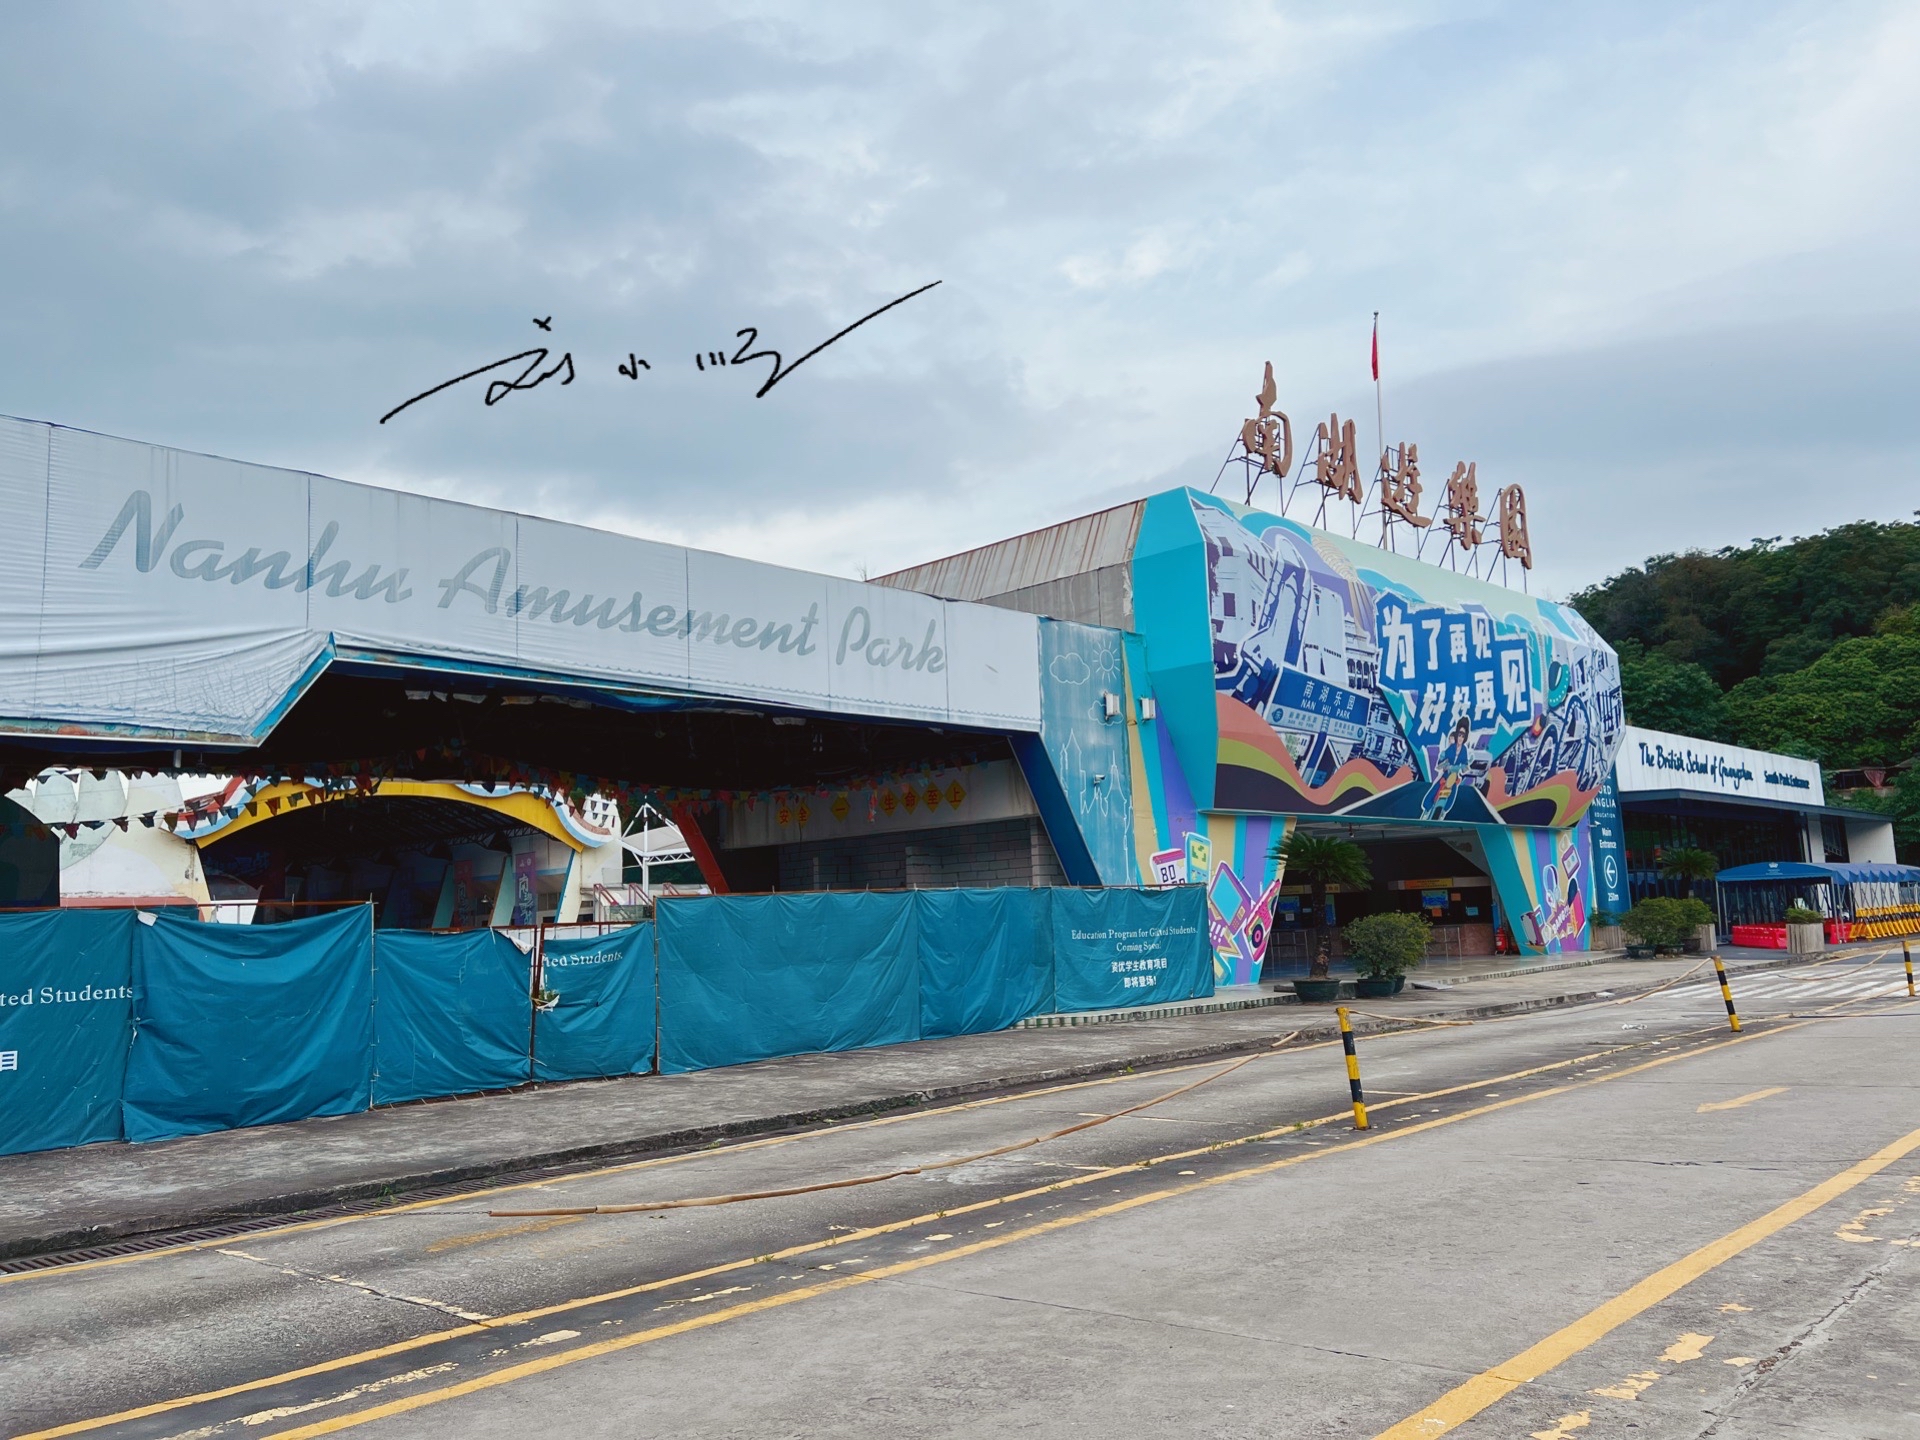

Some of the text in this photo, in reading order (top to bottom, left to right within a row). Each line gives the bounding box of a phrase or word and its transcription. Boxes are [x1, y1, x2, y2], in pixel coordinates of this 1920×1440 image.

[79, 490, 947, 674] Nanhu Amusement Park
[1382, 605, 1492, 681] 为了再见
[1302, 681, 1356, 710] 南湖乐园
[1417, 649, 1527, 736] 好好再见
[1301, 698, 1351, 719] NAN HU PARK
[1639, 742, 1655, 766] The
[1656, 745, 1685, 772] British
[1686, 749, 1708, 774] School
[1710, 756, 1718, 783] of
[1599, 839, 1617, 849] Entrance
[1071, 929, 1107, 940] Education
[1108, 929, 1137, 941] Program
[1138, 928, 1148, 938] for
[1116, 941, 1161, 953] Coming Soon!
[570, 951, 623, 966] Students.
[1111, 958, 1168, 973] 资优学生教育项目
